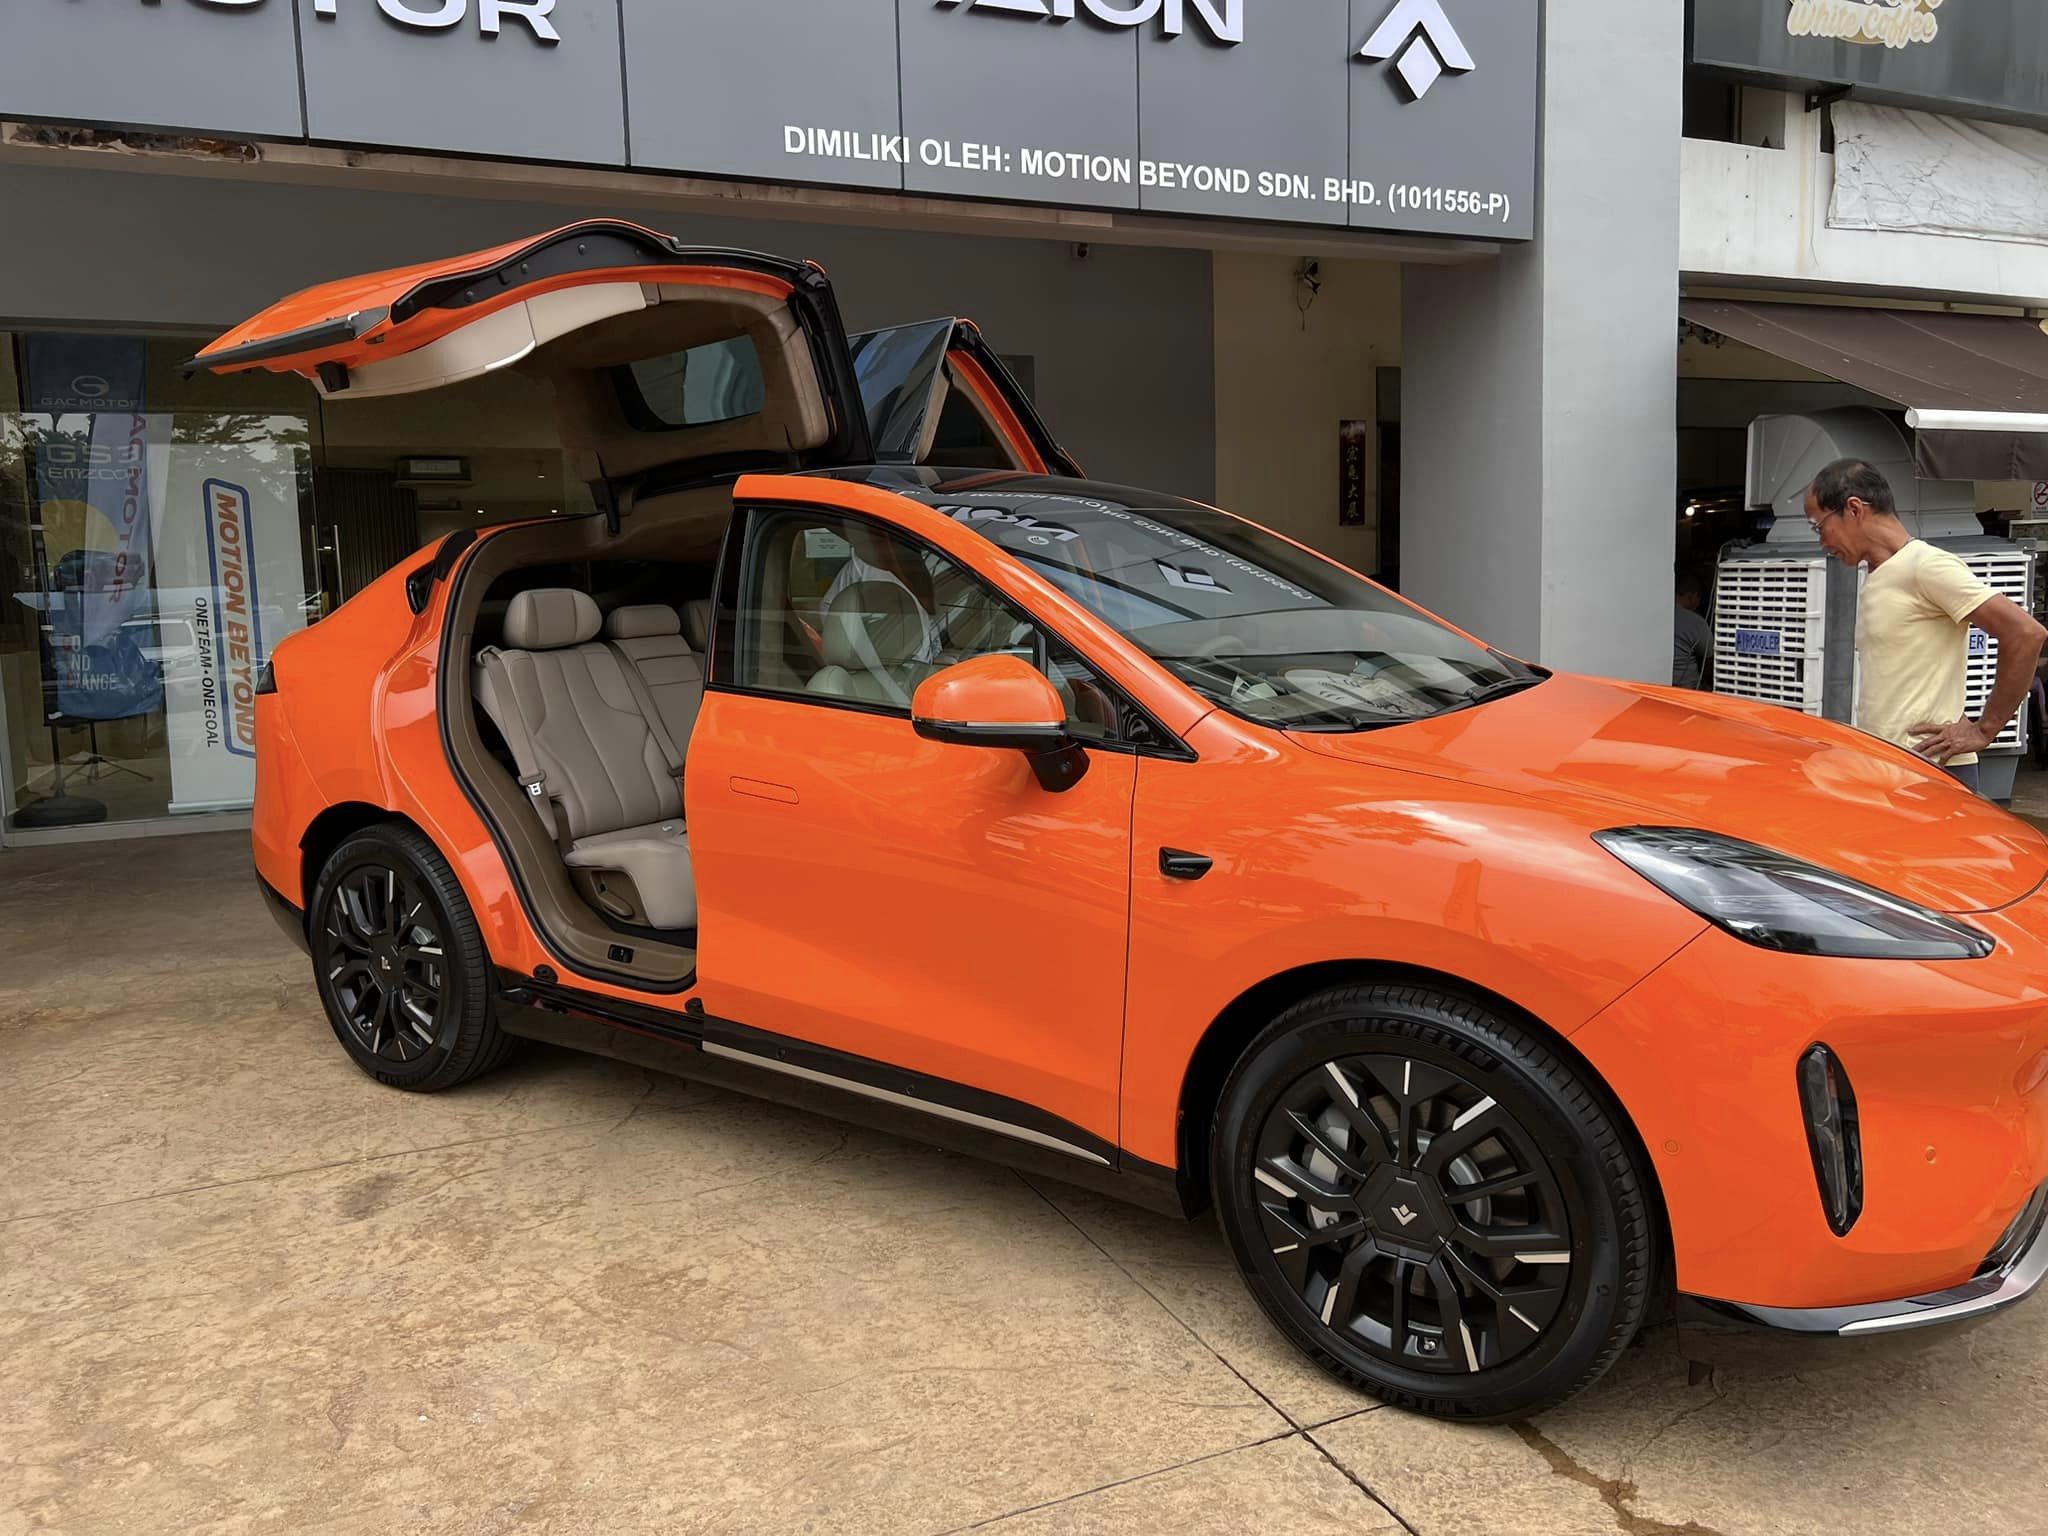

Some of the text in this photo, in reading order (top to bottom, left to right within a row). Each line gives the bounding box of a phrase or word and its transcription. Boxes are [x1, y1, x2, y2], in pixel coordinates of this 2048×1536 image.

[1788, 0, 1937, 48] White Coffee
[784, 126, 1510, 223] DIMILIKI OLEH: MOTION BEYOND SDN. BHD. (1011556-P)
[41, 397, 77, 407] GAC
[46, 443, 141, 464] GS3
[216, 493, 257, 746] MOTION BEYOND
[195, 597, 219, 749] ONE TEAM ONE GOAL
[1346, 1017, 1503, 1072] MICHELIN
